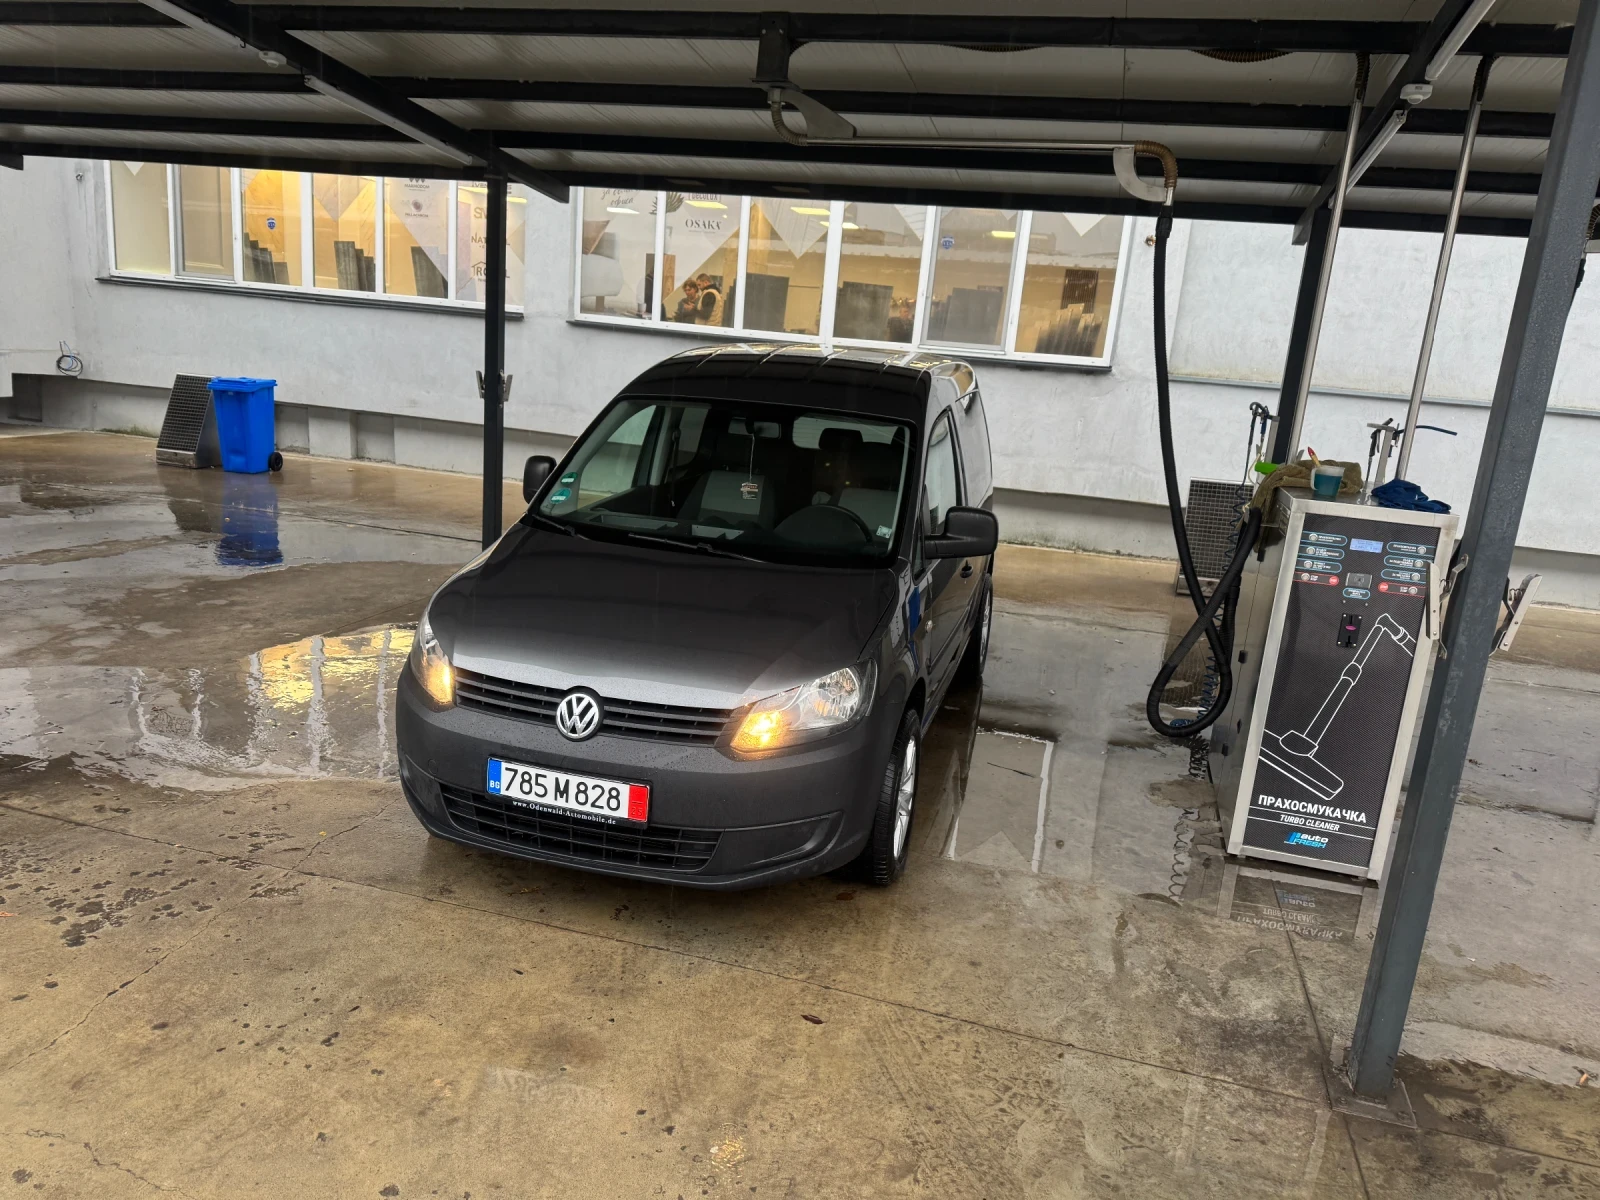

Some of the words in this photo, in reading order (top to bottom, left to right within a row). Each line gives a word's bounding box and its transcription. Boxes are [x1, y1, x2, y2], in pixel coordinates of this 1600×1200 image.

[685, 219, 722, 230] OSAKA
[490, 780, 500, 789] BG
[512, 800, 616, 825] www.Odenwald-Automobile.de
[1258, 794, 1367, 823] ПРАХОСМУКАЧКА
[1280, 814, 1305, 826] TURBO
[1305, 818, 1340, 832] CLEANER
[1300, 833, 1329, 844] auto
